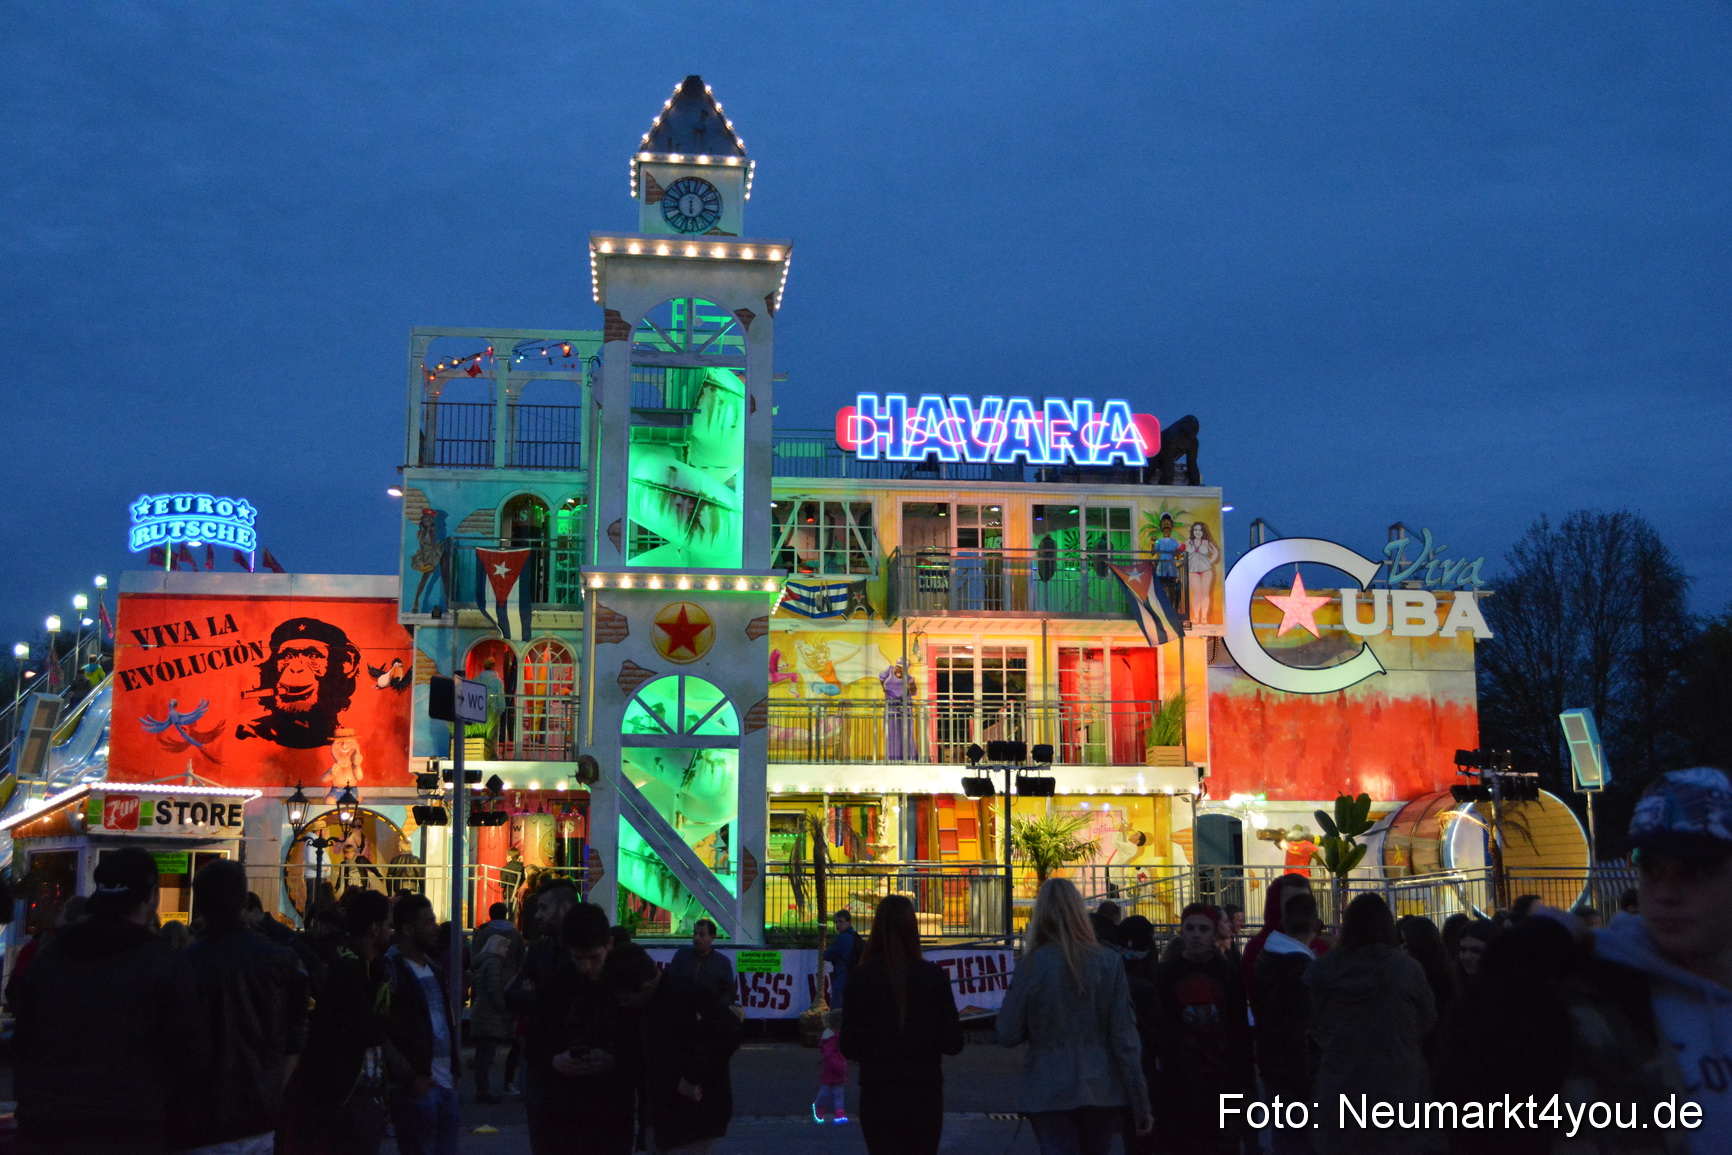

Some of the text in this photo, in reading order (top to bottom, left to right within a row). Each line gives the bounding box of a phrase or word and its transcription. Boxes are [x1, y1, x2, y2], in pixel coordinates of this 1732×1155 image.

[847, 415, 1148, 450] DISCOTECA
[856, 392, 1148, 466] HAVANA
[154, 497, 233, 516] EURO
[135, 520, 251, 547] RUTSCHE
[1384, 527, 1485, 587] Viva
[131, 613, 239, 651] VIVA LA
[1223, 537, 1493, 694] CUBA
[468, 693, 484, 710] WC
[155, 800, 242, 827] STORE
